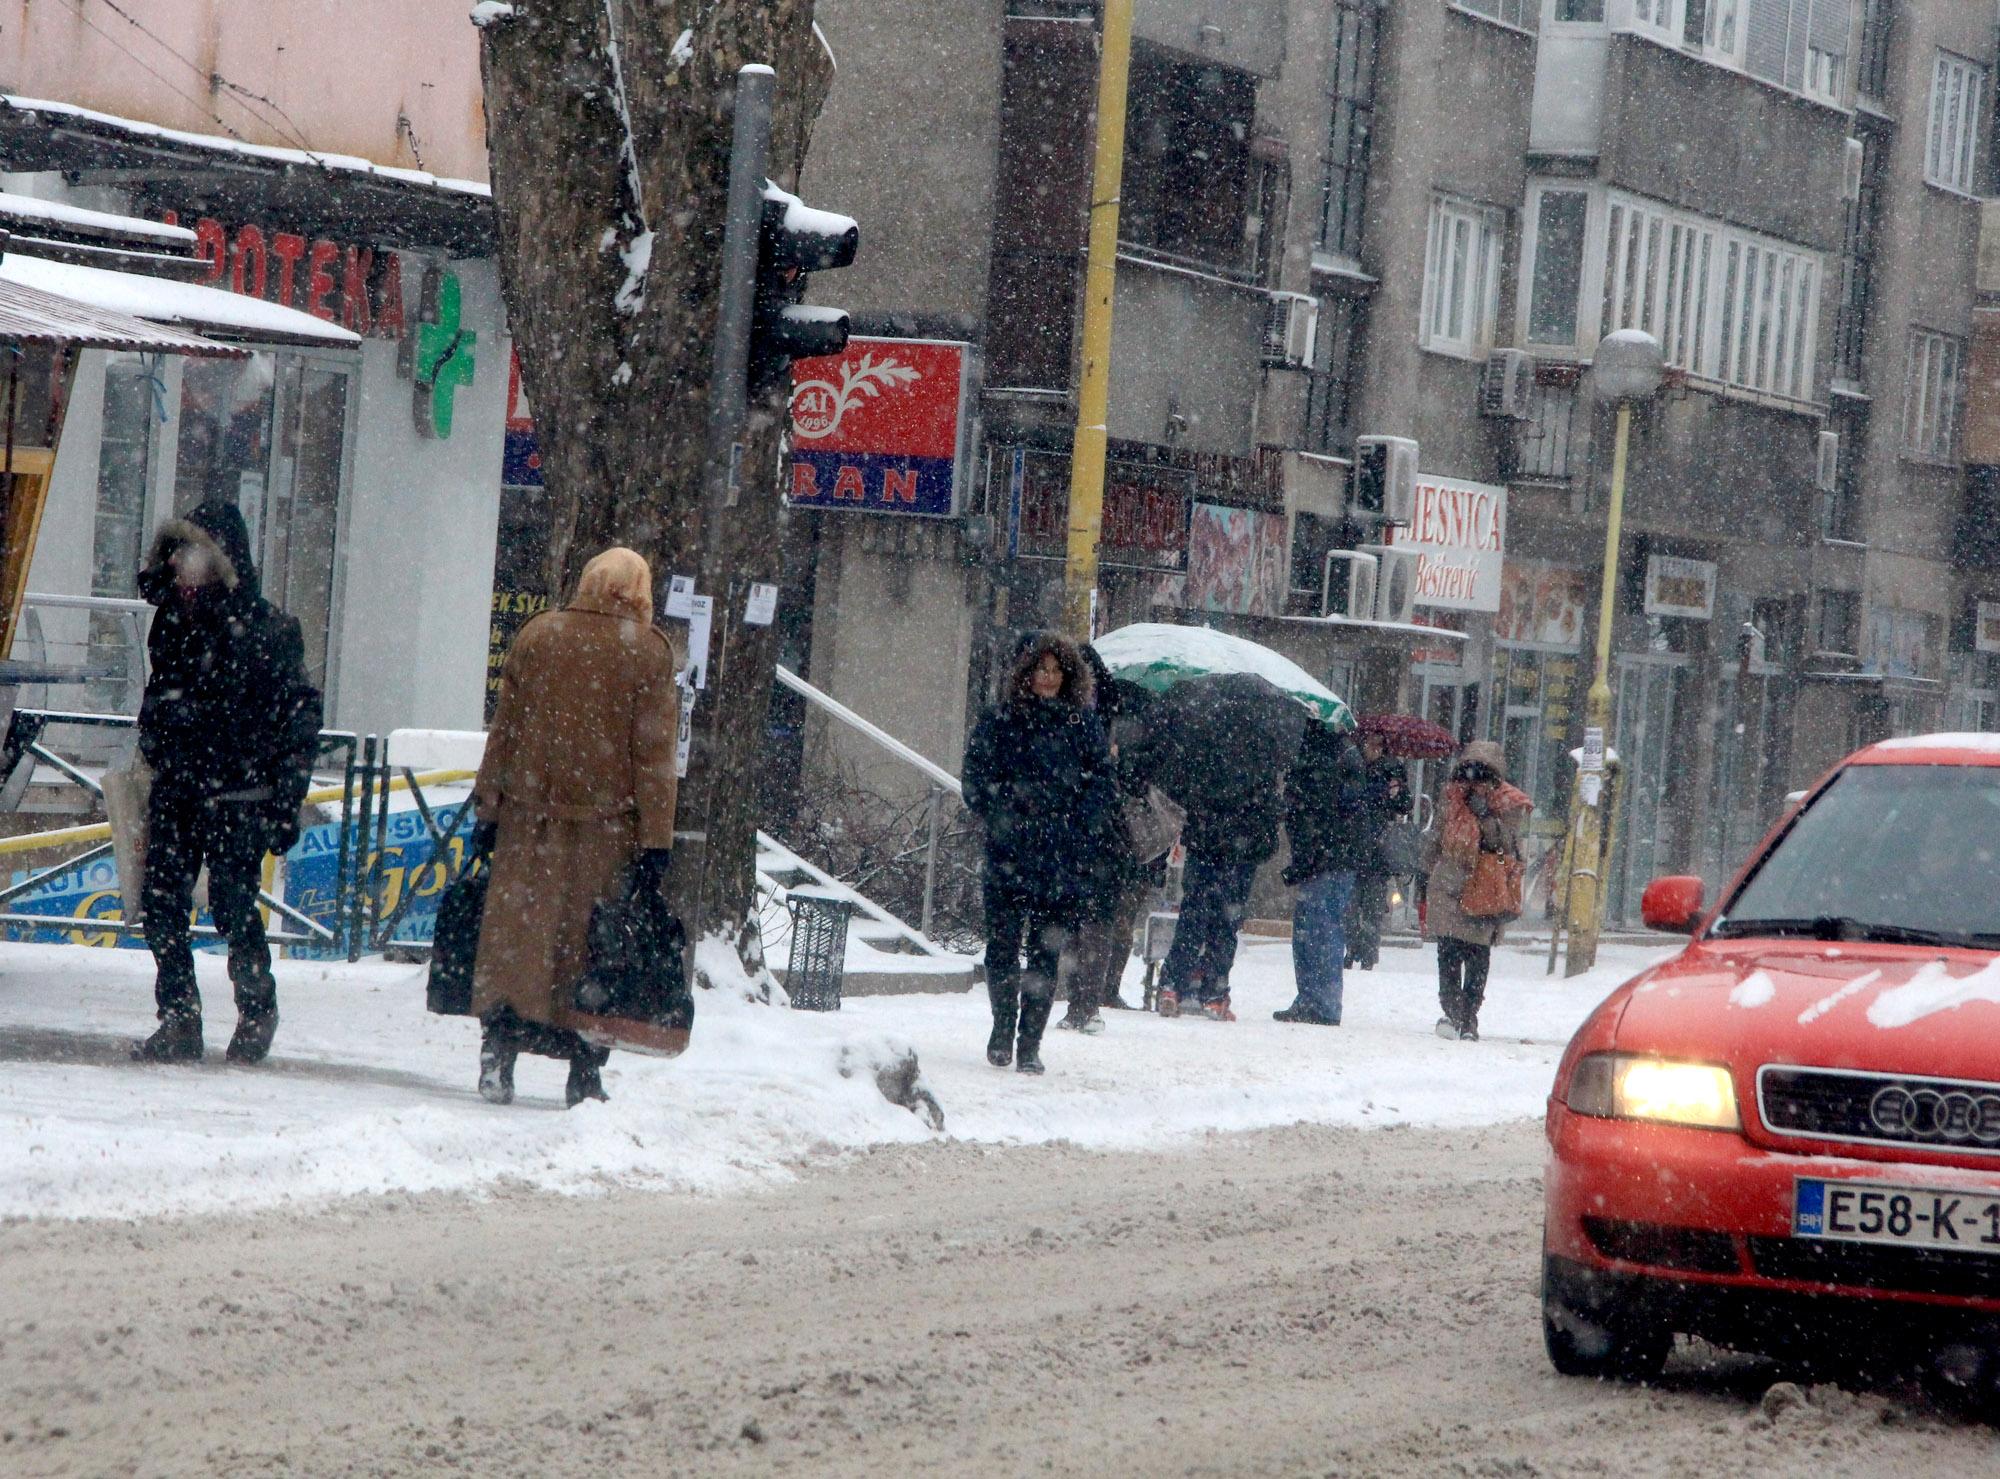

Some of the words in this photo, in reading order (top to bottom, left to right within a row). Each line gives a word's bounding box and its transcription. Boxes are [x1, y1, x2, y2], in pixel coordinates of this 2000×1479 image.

[164, 209, 405, 341] POTEKA
[1799, 1213, 1822, 1228] BIH
[1829, 1191, 2000, 1243] E58-K-1
